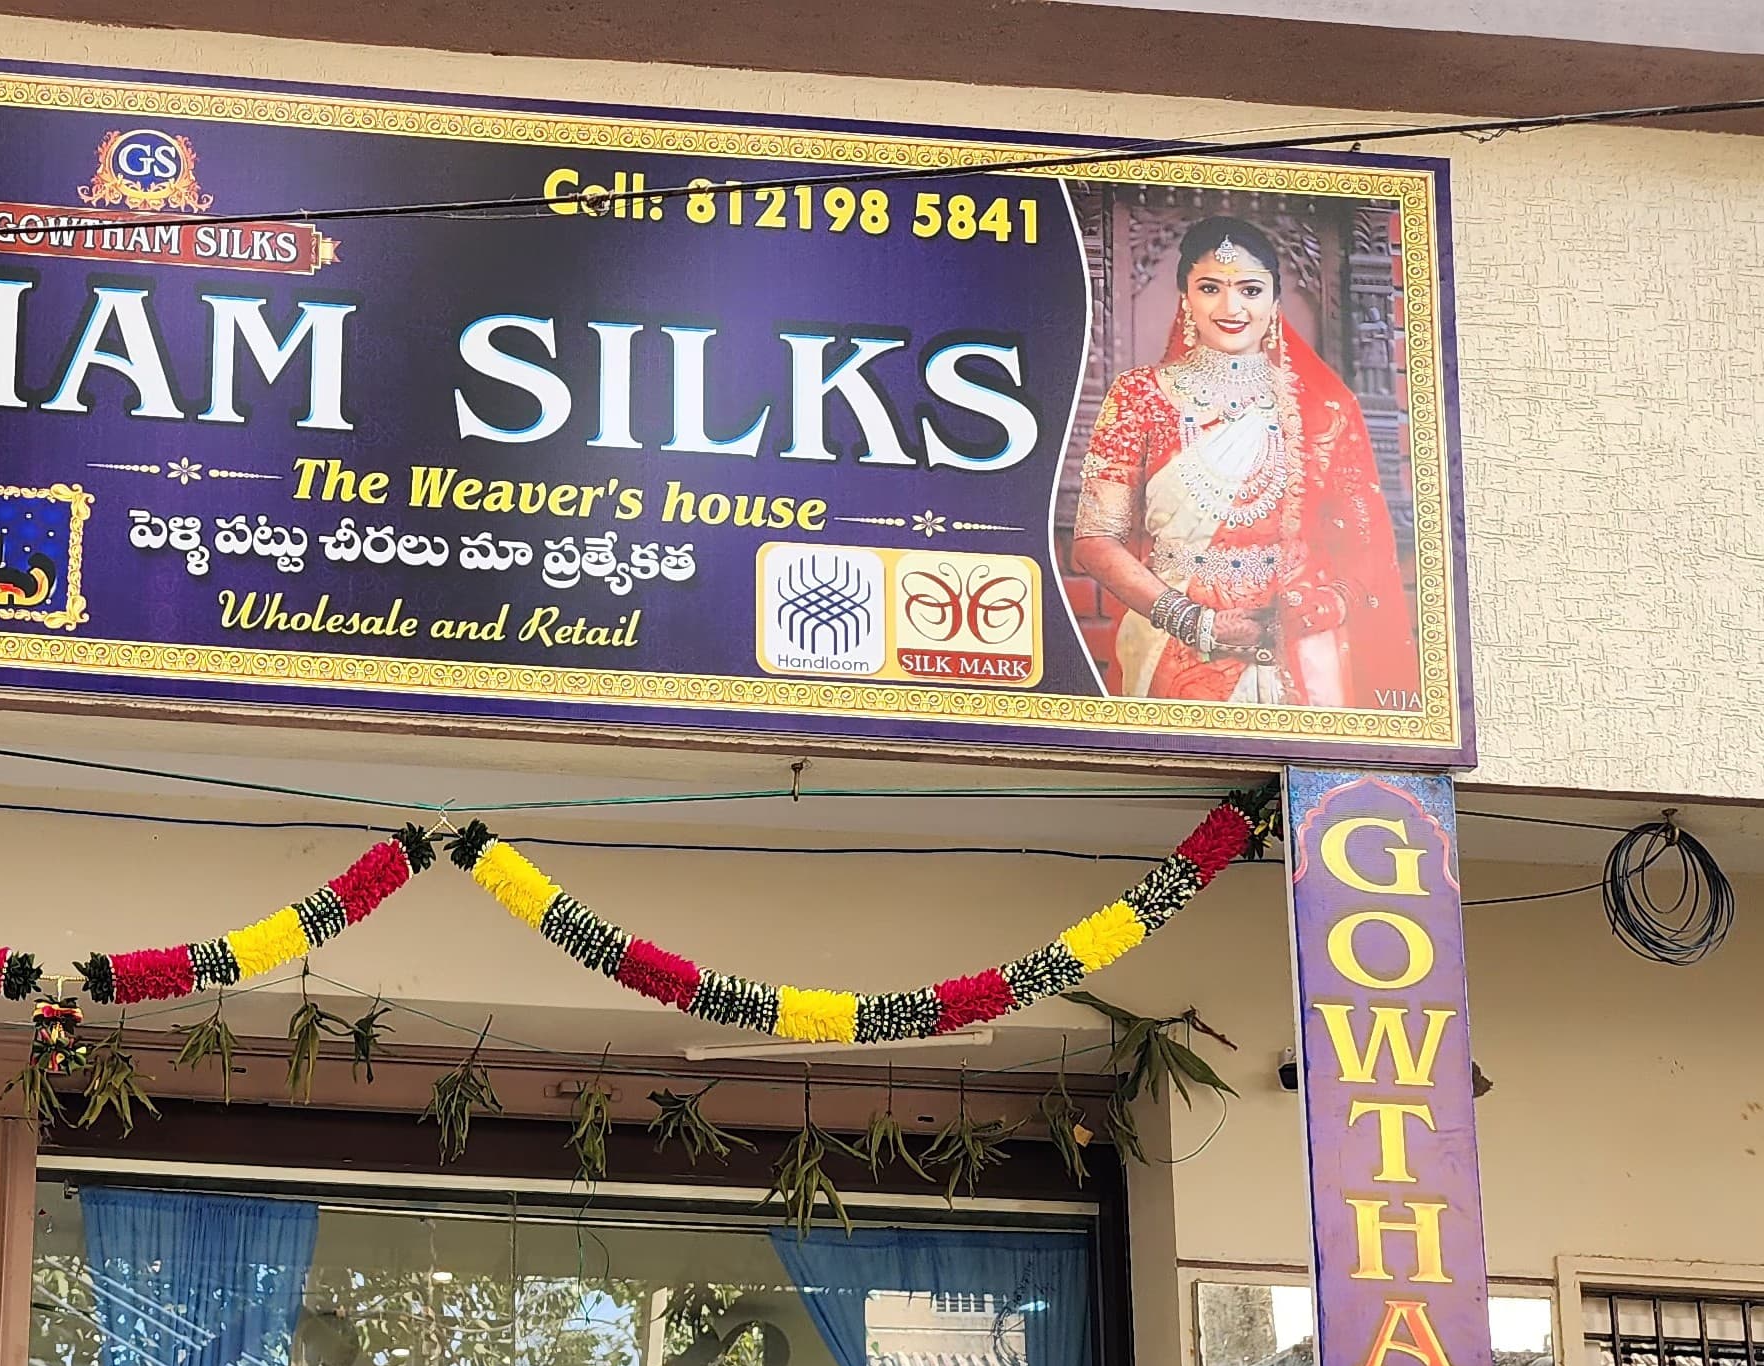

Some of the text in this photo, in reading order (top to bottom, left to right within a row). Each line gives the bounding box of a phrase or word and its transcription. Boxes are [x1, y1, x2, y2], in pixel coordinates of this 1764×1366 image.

[118, 143, 178, 178] GS
[686, 178, 890, 235] 812198
[912, 191, 1038, 244] 5841
[195, 227, 299, 263] SILKS
[453, 314, 1039, 473] SILKS
[292, 457, 828, 532] The Weaver's house
[214, 515, 308, 573] పట్టు
[319, 517, 449, 568] చీరలు
[459, 531, 534, 571] మా
[541, 530, 697, 596] ప్రత్యేకత
[218, 589, 642, 648] Wholesale and Retail
[777, 653, 870, 672] Handloom
[901, 653, 1029, 679] SILK MARK
